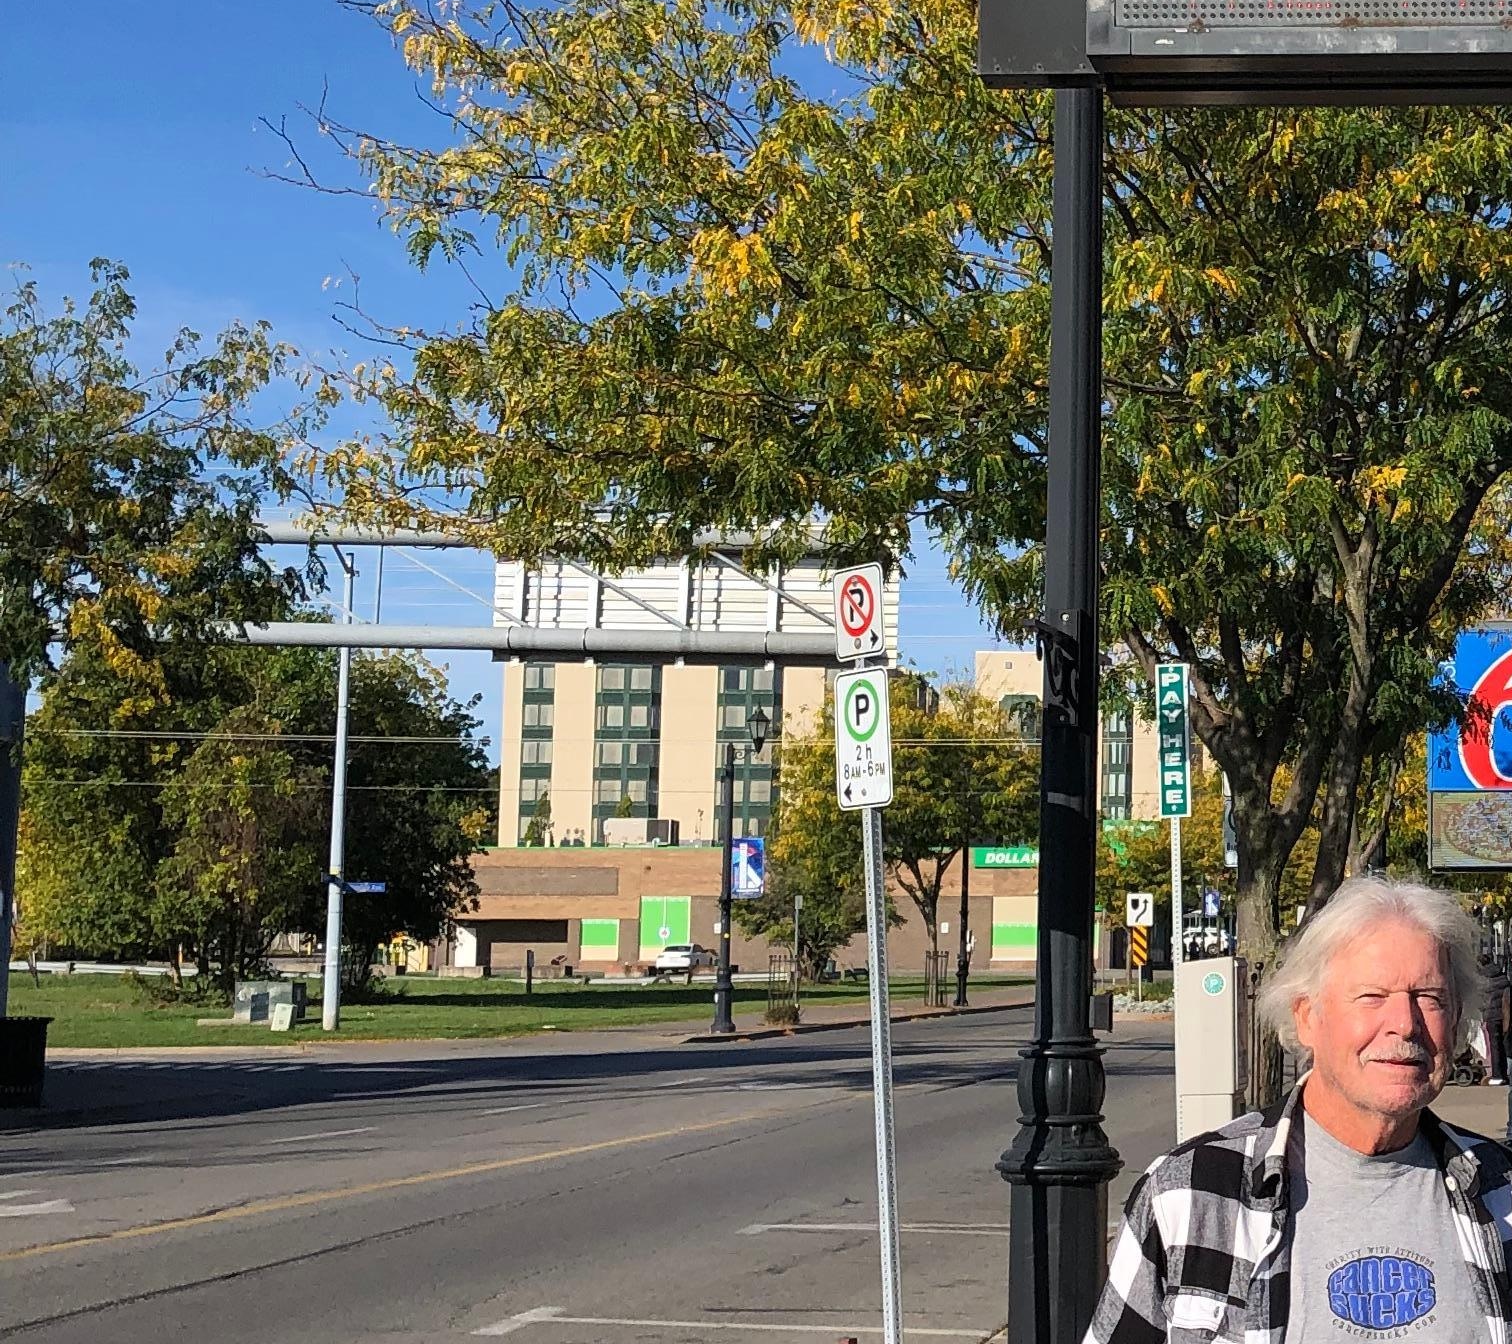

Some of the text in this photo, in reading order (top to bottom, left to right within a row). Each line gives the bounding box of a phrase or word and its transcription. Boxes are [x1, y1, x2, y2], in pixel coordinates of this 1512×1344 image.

[855, 693, 870, 726] P
[856, 743, 872, 761] 2 h
[1161, 672, 1184, 805] PAY HERE
